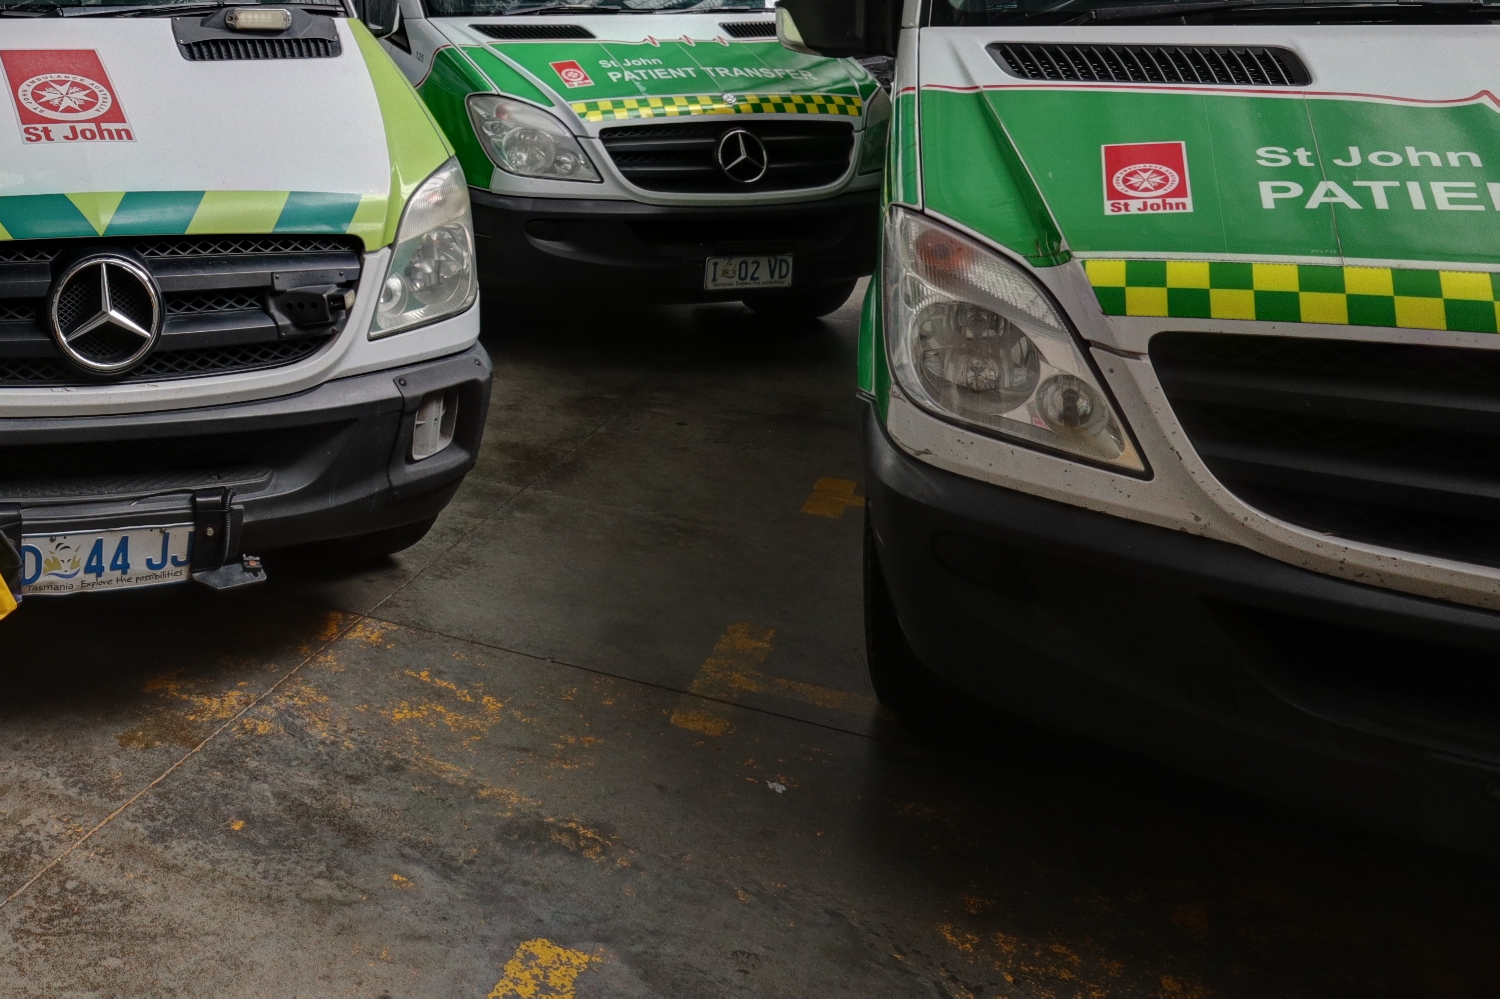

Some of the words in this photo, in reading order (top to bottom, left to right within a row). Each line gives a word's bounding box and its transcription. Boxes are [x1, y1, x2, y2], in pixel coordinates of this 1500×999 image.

[598, 59, 619, 68] St
[623, 57, 663, 67] John
[607, 67, 697, 82] PATIENT
[700, 66, 818, 80] TRANSFER
[22, 89, 32, 105] JOHN
[27, 75, 85, 88] AMBULANCE
[89, 82, 108, 113] AUSTRALIA
[23, 126, 55, 142] St
[63, 124, 133, 141] John
[1256, 147, 1314, 167] St
[1333, 146, 1483, 167] John
[1110, 202, 1131, 213] St
[1137, 199, 1187, 212] John
[1258, 181, 1500, 211] PATIE
[738, 260, 760, 281] 02
[768, 259, 790, 279] VD
[22, 545, 43, 586] D
[84, 536, 130, 577] 44
[146, 530, 195, 571] JJ
[27, 583, 74, 592] Tasmania
[80, 578, 113, 588] Explore
[115, 575, 133, 585] the
[135, 569, 183, 584] possibilities
